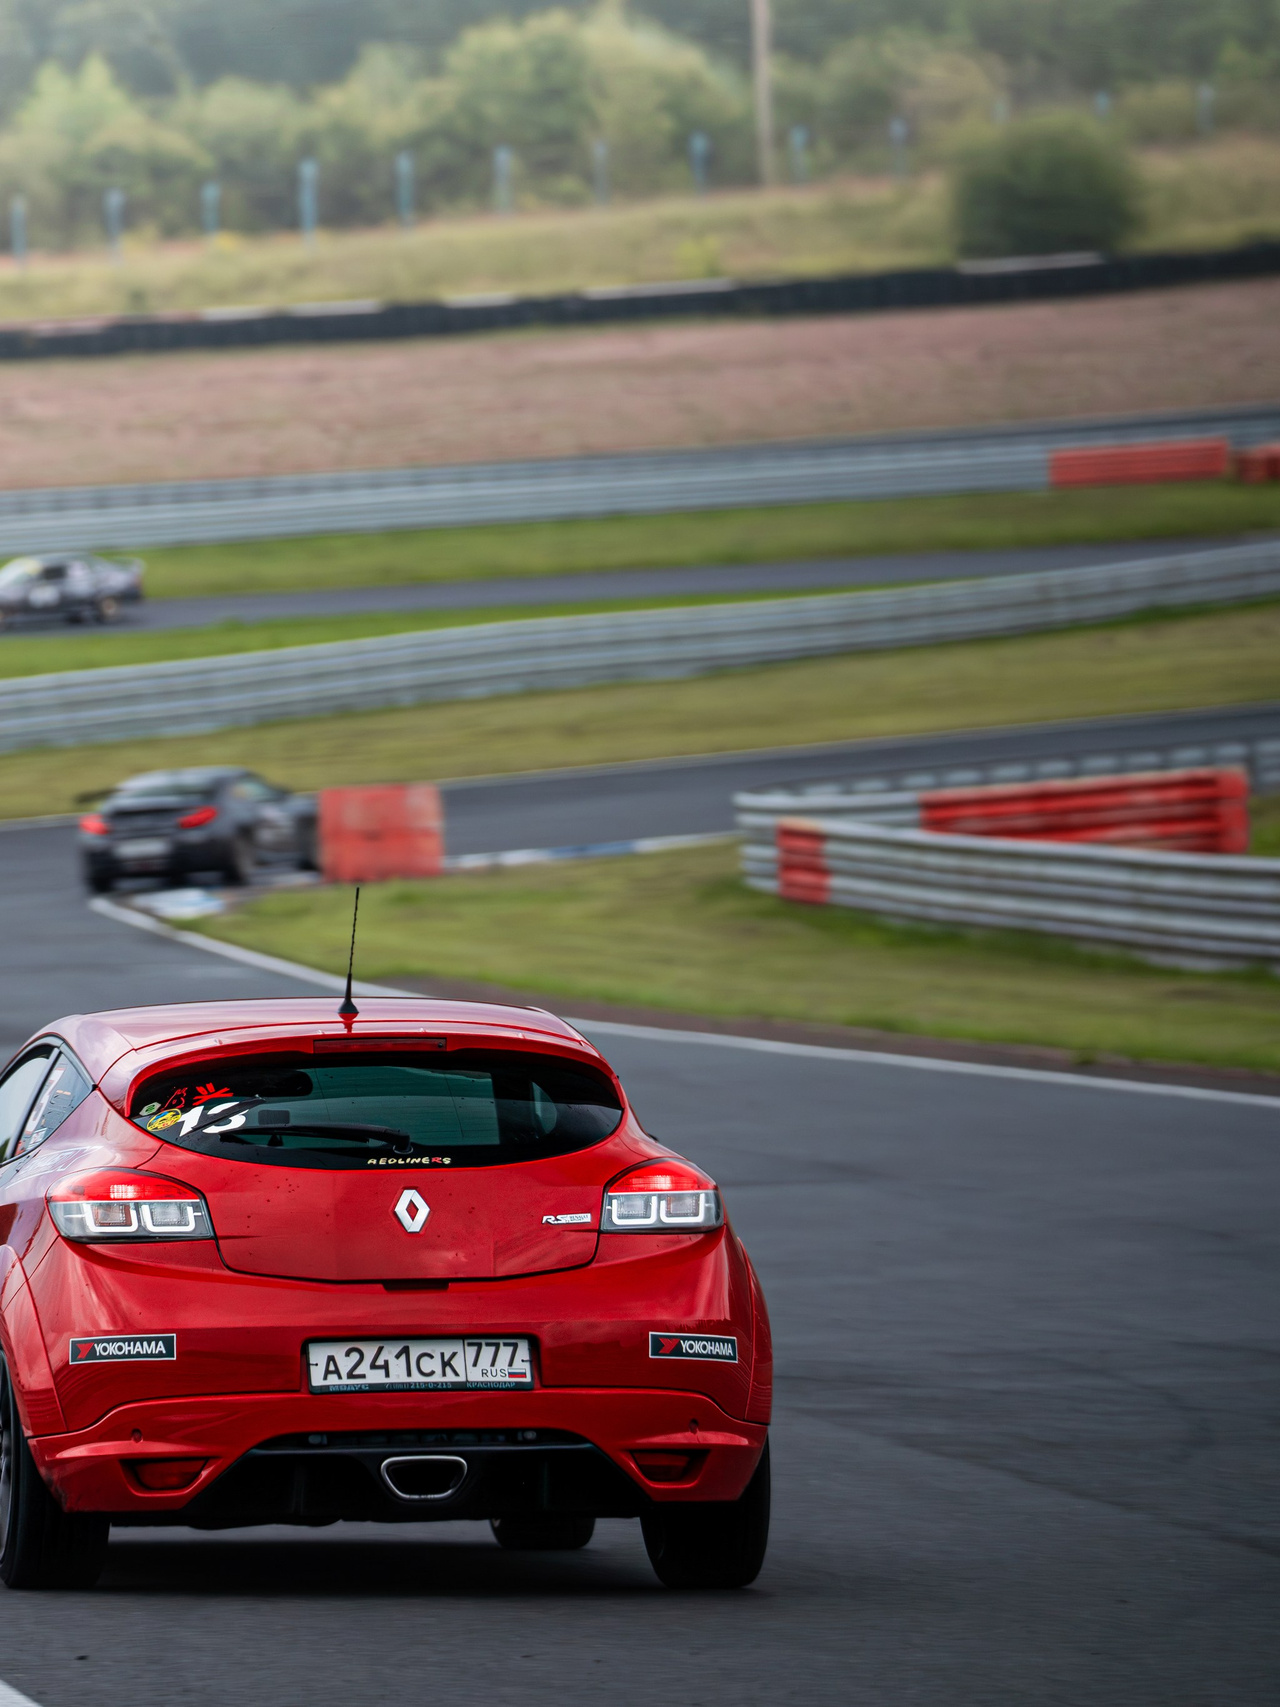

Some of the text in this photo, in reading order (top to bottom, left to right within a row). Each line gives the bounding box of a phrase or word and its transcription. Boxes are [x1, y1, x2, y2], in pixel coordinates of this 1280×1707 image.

[178, 1101, 249, 1137] 13
[367, 1156, 452, 1165] REDLINERS
[94, 1340, 166, 1356] YOKOHAMA
[680, 1340, 734, 1356] YOKOHAMA
[322, 1342, 519, 1380] A241CK 777
[481, 1368, 507, 1378] RUS
